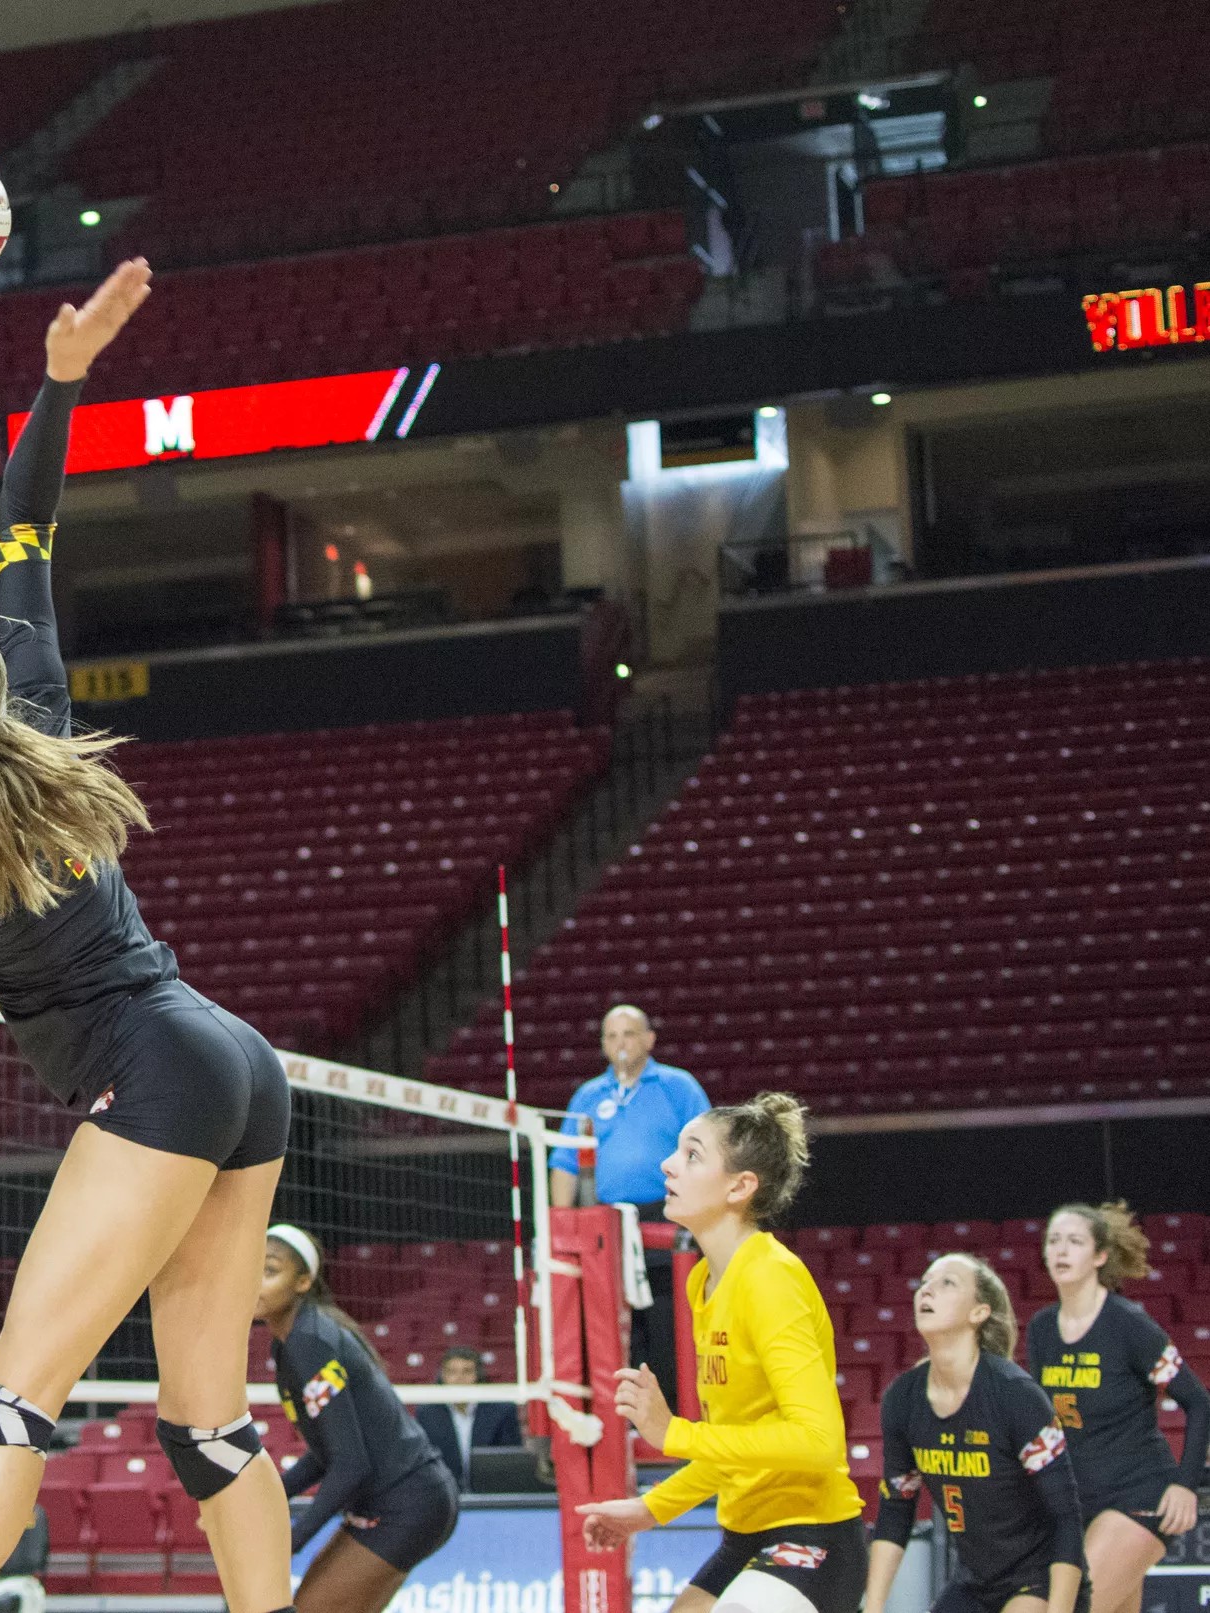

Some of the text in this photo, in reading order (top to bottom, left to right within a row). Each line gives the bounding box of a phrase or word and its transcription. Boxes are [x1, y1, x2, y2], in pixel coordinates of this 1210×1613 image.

[142, 395, 196, 456] M
[912, 1447, 990, 1477] MARYLAND
[943, 1484, 966, 1532] 5
